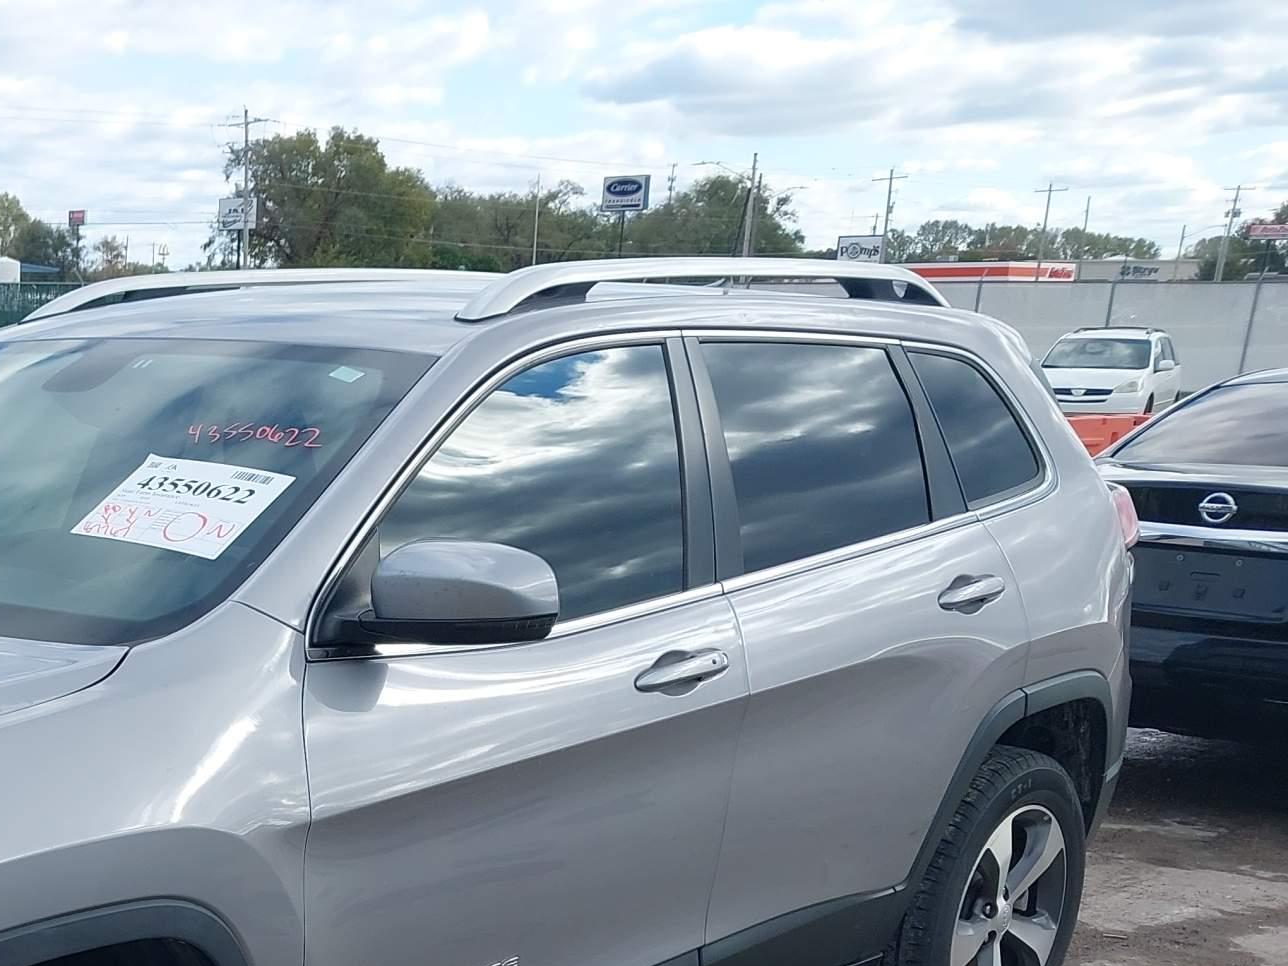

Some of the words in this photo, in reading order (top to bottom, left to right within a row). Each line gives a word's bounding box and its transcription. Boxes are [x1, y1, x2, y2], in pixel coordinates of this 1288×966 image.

[610, 183, 638, 192] Carrier
[187, 422, 323, 448] 43550622
[137, 475, 256, 504] 43550622
